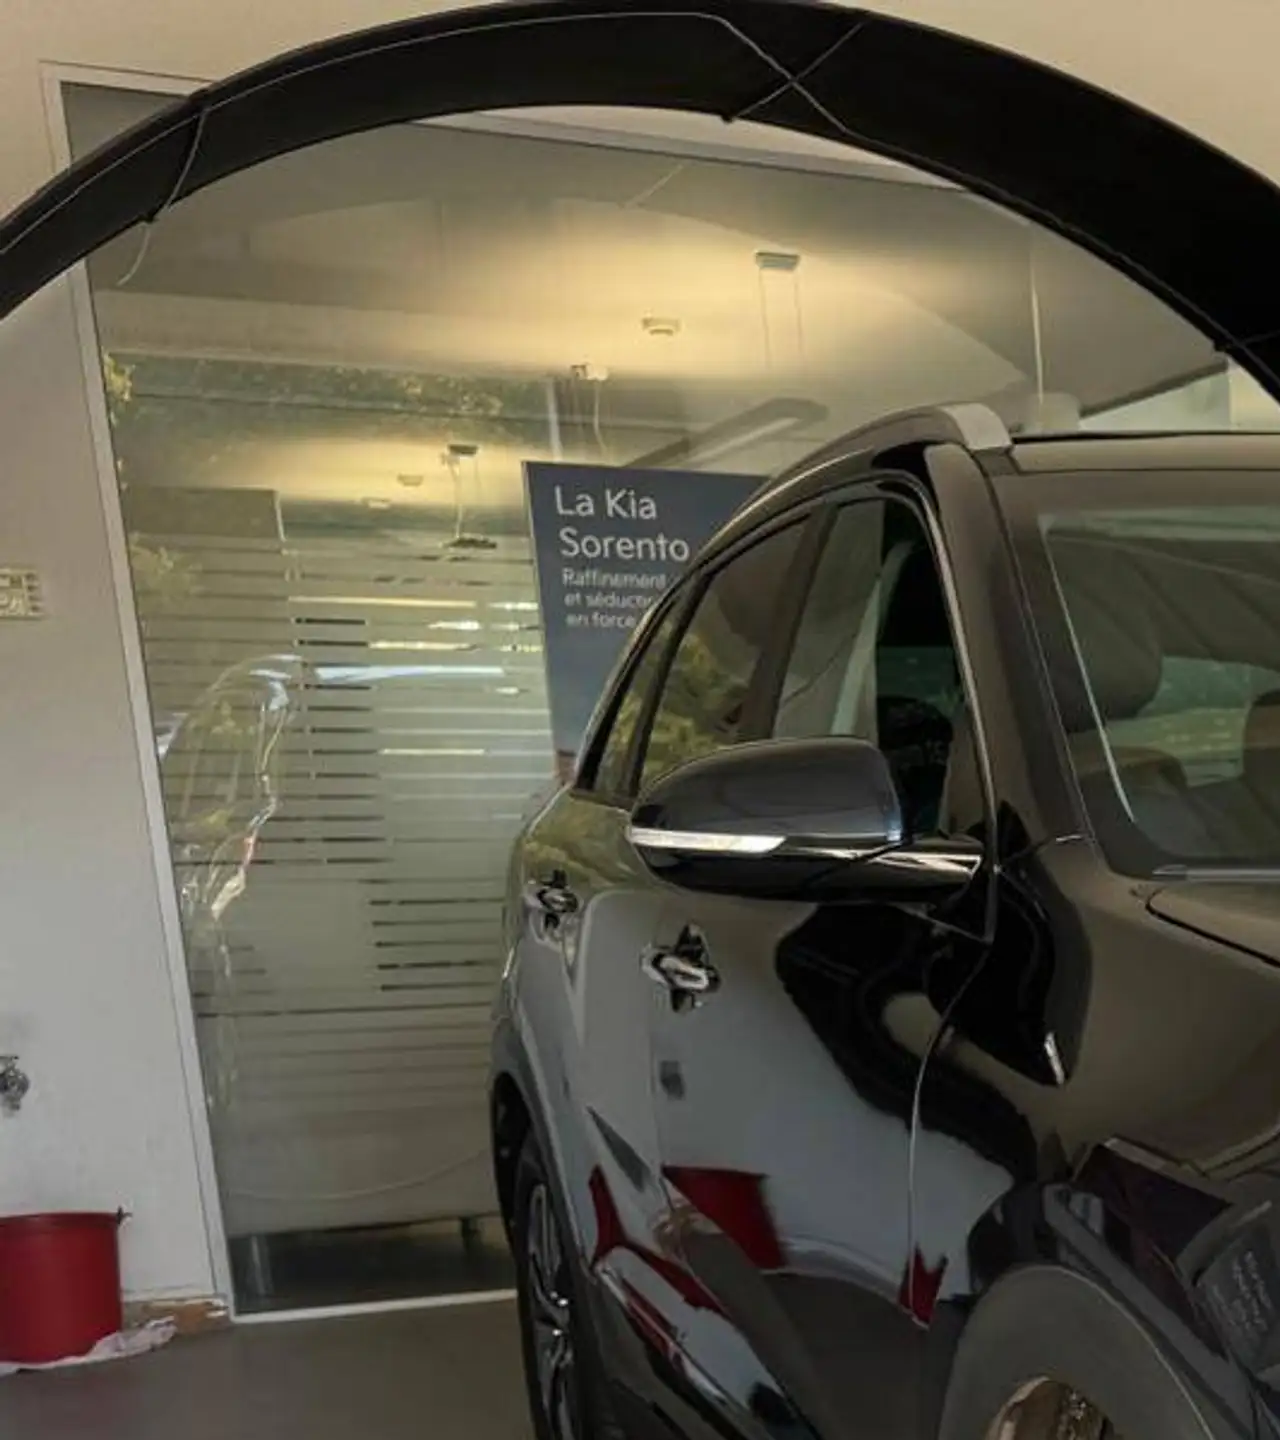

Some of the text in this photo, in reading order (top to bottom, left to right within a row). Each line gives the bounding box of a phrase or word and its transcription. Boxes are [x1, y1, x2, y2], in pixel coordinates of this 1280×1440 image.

[554, 485, 658, 521] La Kia
[559, 527, 690, 562] Sorento
[562, 569, 667, 591] Raffinement
[564, 592, 583, 607] et
[593, 610, 636, 628] force
